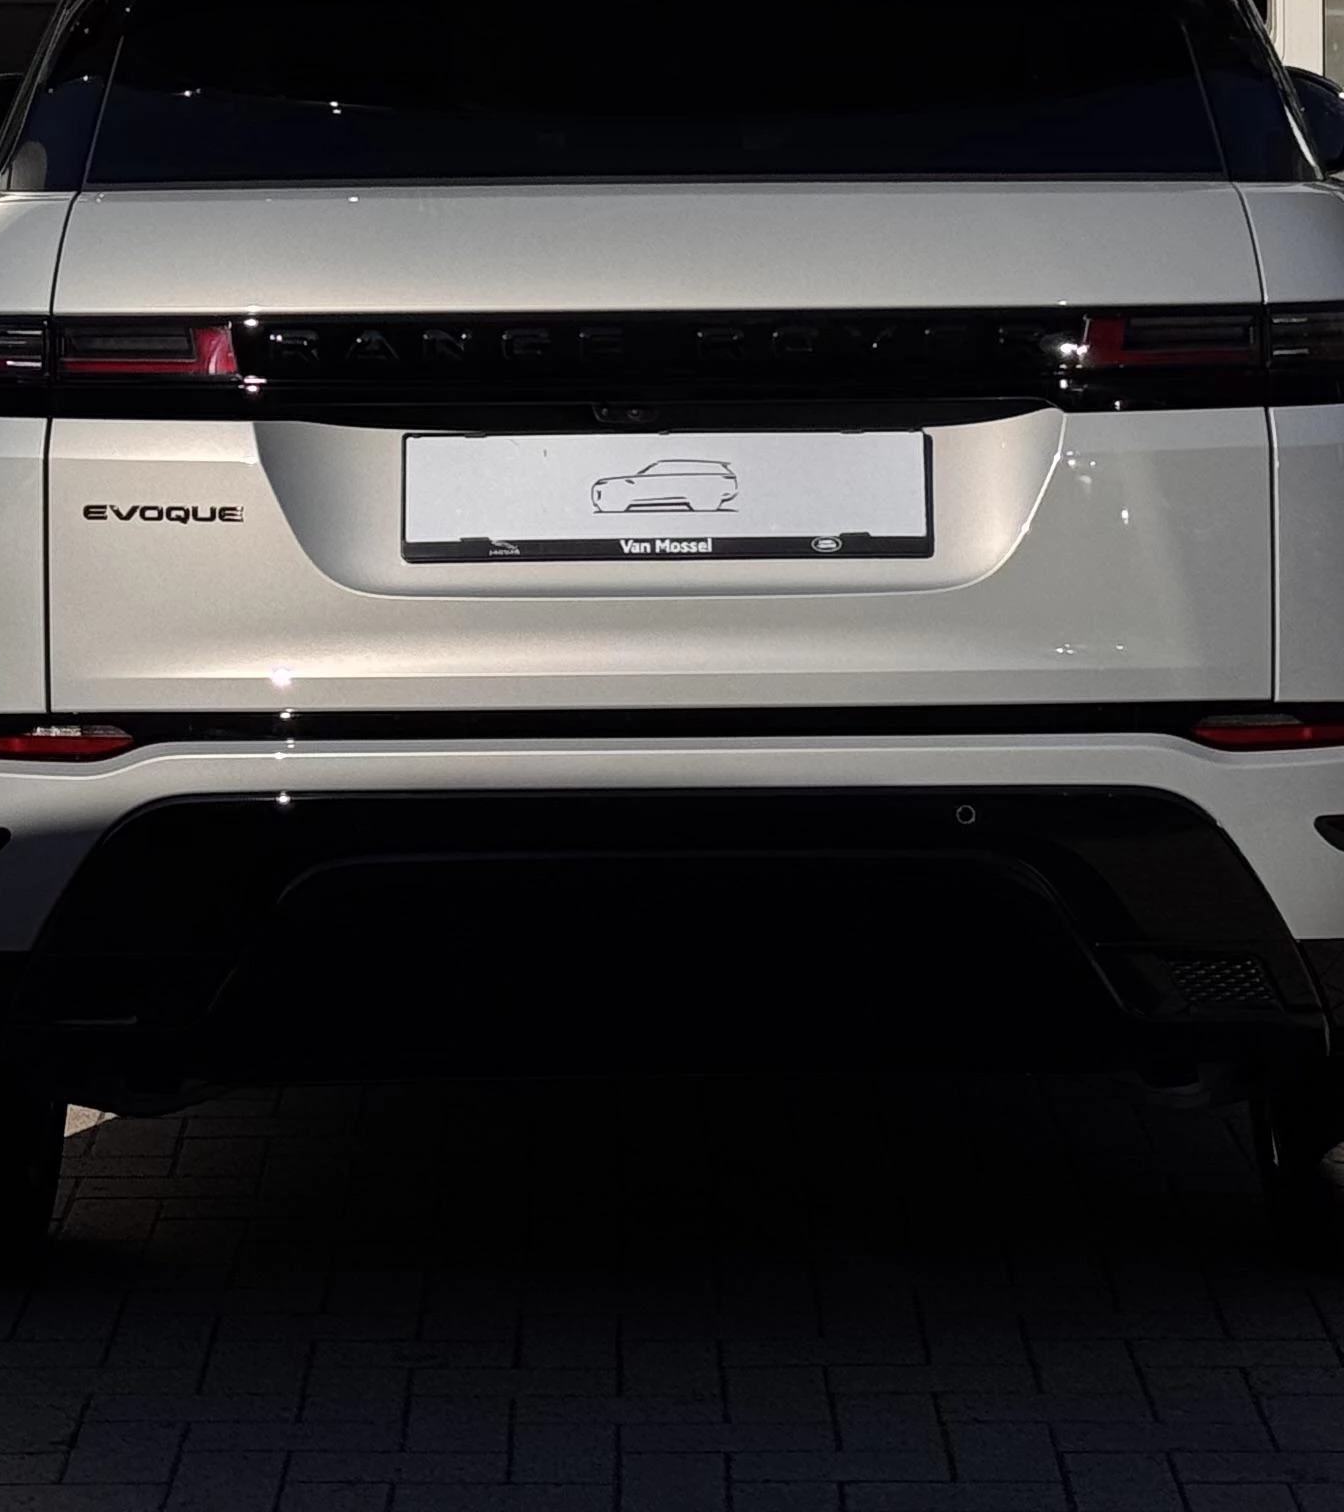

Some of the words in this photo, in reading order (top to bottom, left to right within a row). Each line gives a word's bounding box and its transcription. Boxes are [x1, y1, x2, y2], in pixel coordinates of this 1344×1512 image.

[268, 327, 626, 363] RANGE
[696, 322, 1044, 360] ROVER
[83, 505, 244, 524] EVOQUE
[620, 538, 652, 553] Van
[655, 537, 712, 553] Mossel
